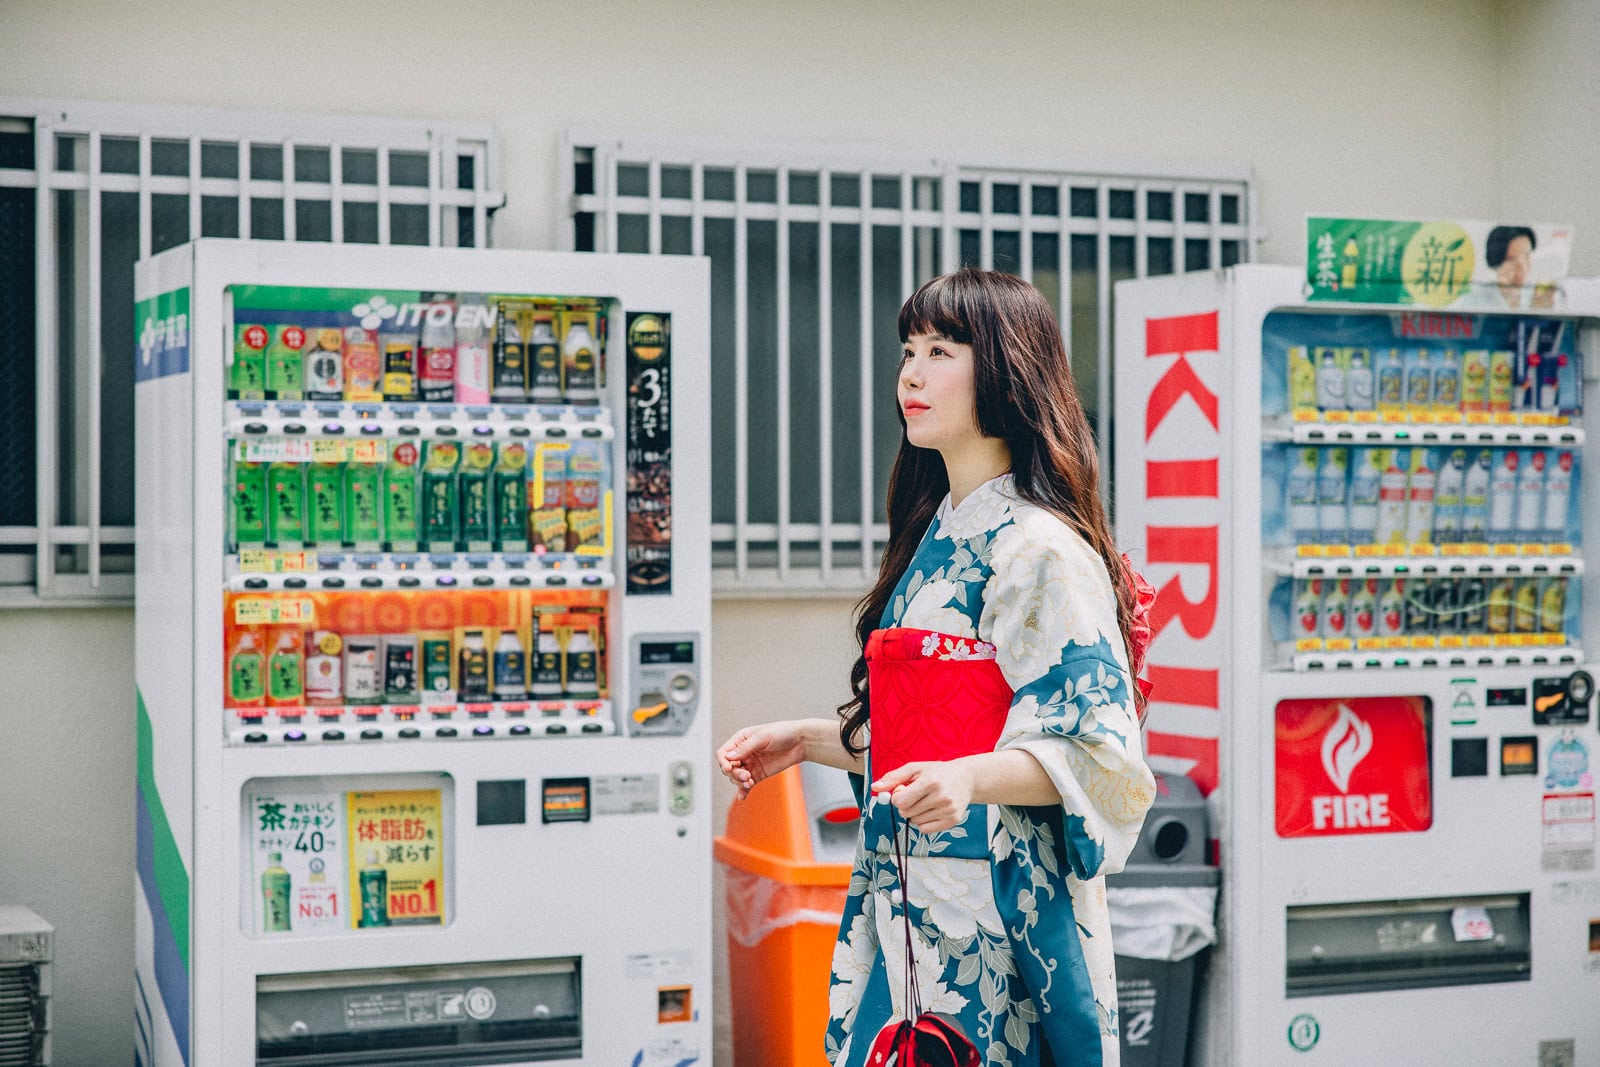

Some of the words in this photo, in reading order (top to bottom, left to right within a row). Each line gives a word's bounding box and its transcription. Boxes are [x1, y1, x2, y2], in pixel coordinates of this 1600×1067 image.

[1315, 231, 1338, 288] 生茶
[1413, 235, 1465, 294] 新
[395, 302, 457, 327] ITO
[454, 304, 498, 329] EN
[1401, 312, 1473, 338] KIRIN
[258, 803, 287, 831] 茶
[293, 802, 334, 813] おいしく
[1312, 794, 1391, 830] FIRE
[289, 815, 336, 831] カテキン
[357, 818, 434, 842] 体脂肪を
[385, 845, 435, 864] 減らす
[298, 892, 339, 919] No.1
